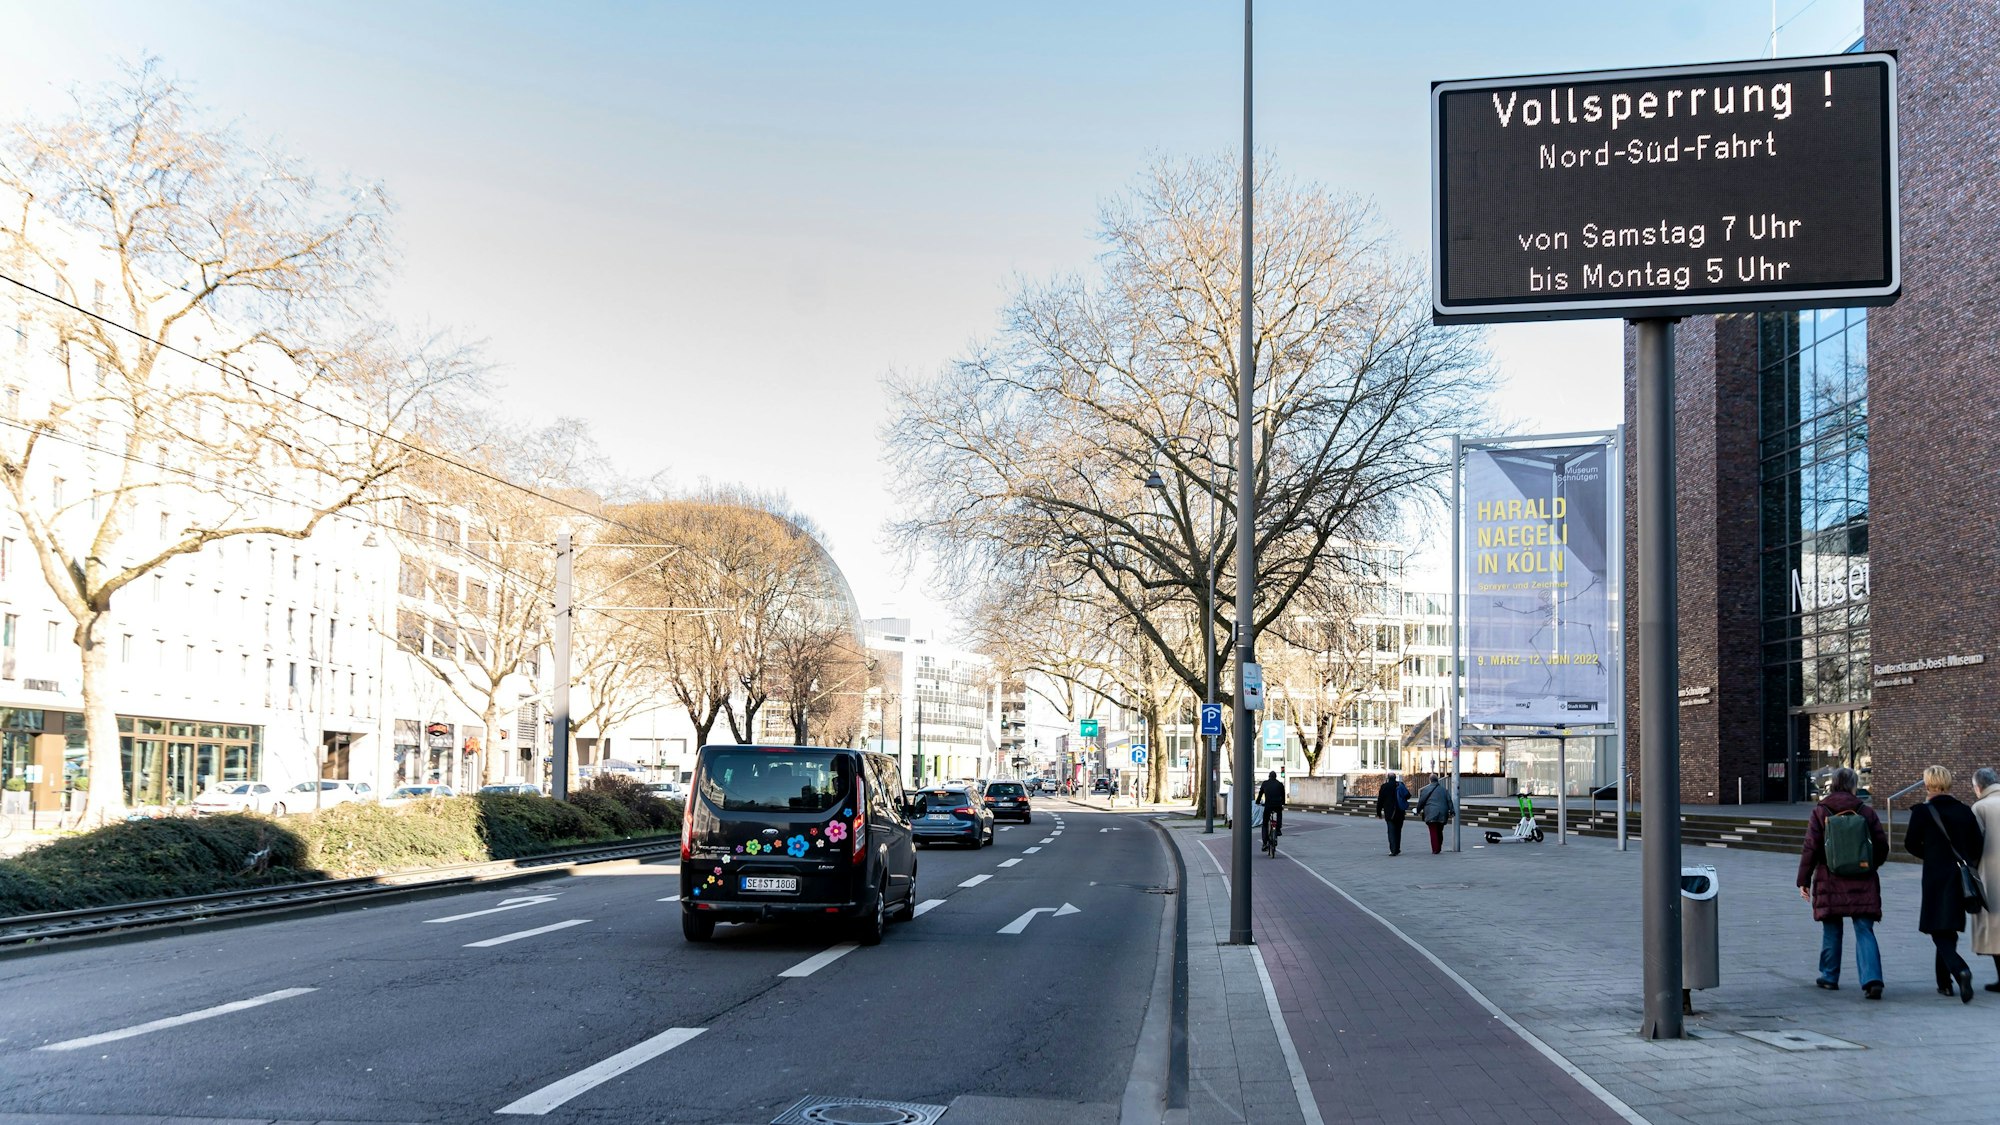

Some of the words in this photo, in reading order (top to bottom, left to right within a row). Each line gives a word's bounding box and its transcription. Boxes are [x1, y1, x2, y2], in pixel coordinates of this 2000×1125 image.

[1492, 80, 1792, 130] Vollsperrung
[1823, 70, 1832, 108] !
[1540, 130, 1777, 170] Nord-Süd-Fahrt
[1518, 230, 1568, 252] von
[1582, 219, 1705, 249] Samstag
[1721, 215, 1736, 242] 7
[1749, 213, 1802, 240] Uhr
[1530, 265, 1569, 292] bis
[1583, 260, 1690, 290] Montag
[1706, 257, 1723, 284] 5
[1738, 255, 1791, 282] Uhr
[1557, 473, 1599, 482] Schnütgen
[1564, 466, 1598, 474] Museum
[1477, 497, 1567, 522] HARALD
[1477, 523, 1568, 549] NAEGELI
[1477, 552, 1498, 575] IN
[1506, 547, 1564, 574] KÖLN
[1479, 582, 1510, 592] Sprayer
[1512, 582, 1529, 590] und
[1531, 580, 1569, 589] Zeichner
[1477, 655, 1486, 666] 9.
[1573, 653, 1599, 664] 2022
[1207, 711, 1217, 723] P
[1135, 750, 1143, 762] P
[747, 878, 757, 889] SE
[763, 879, 773, 889] ST
[775, 880, 796, 889] 1808
